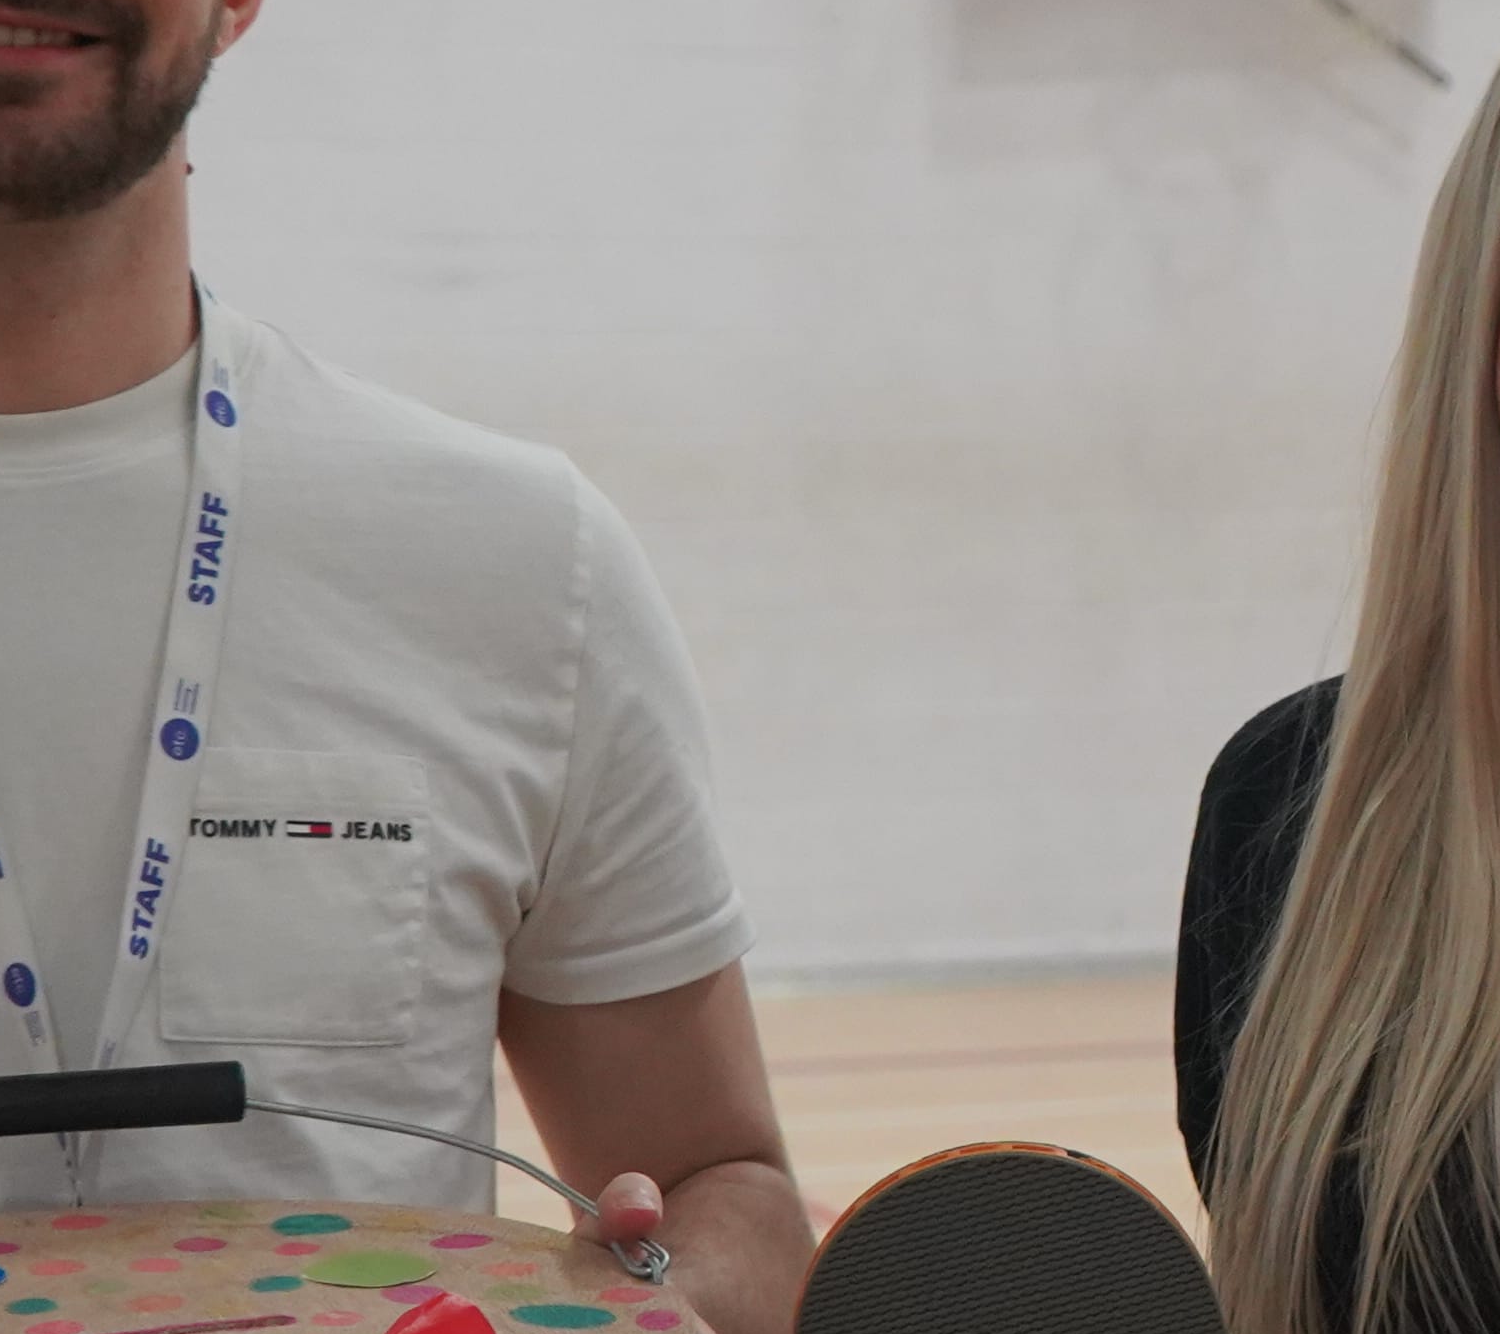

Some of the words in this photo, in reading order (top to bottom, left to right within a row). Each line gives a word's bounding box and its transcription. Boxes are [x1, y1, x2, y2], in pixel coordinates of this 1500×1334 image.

[188, 490, 229, 606] STAFF
[189, 818, 277, 838] TOMMY
[340, 821, 413, 842] JEANS
[128, 837, 170, 960] STAFF
